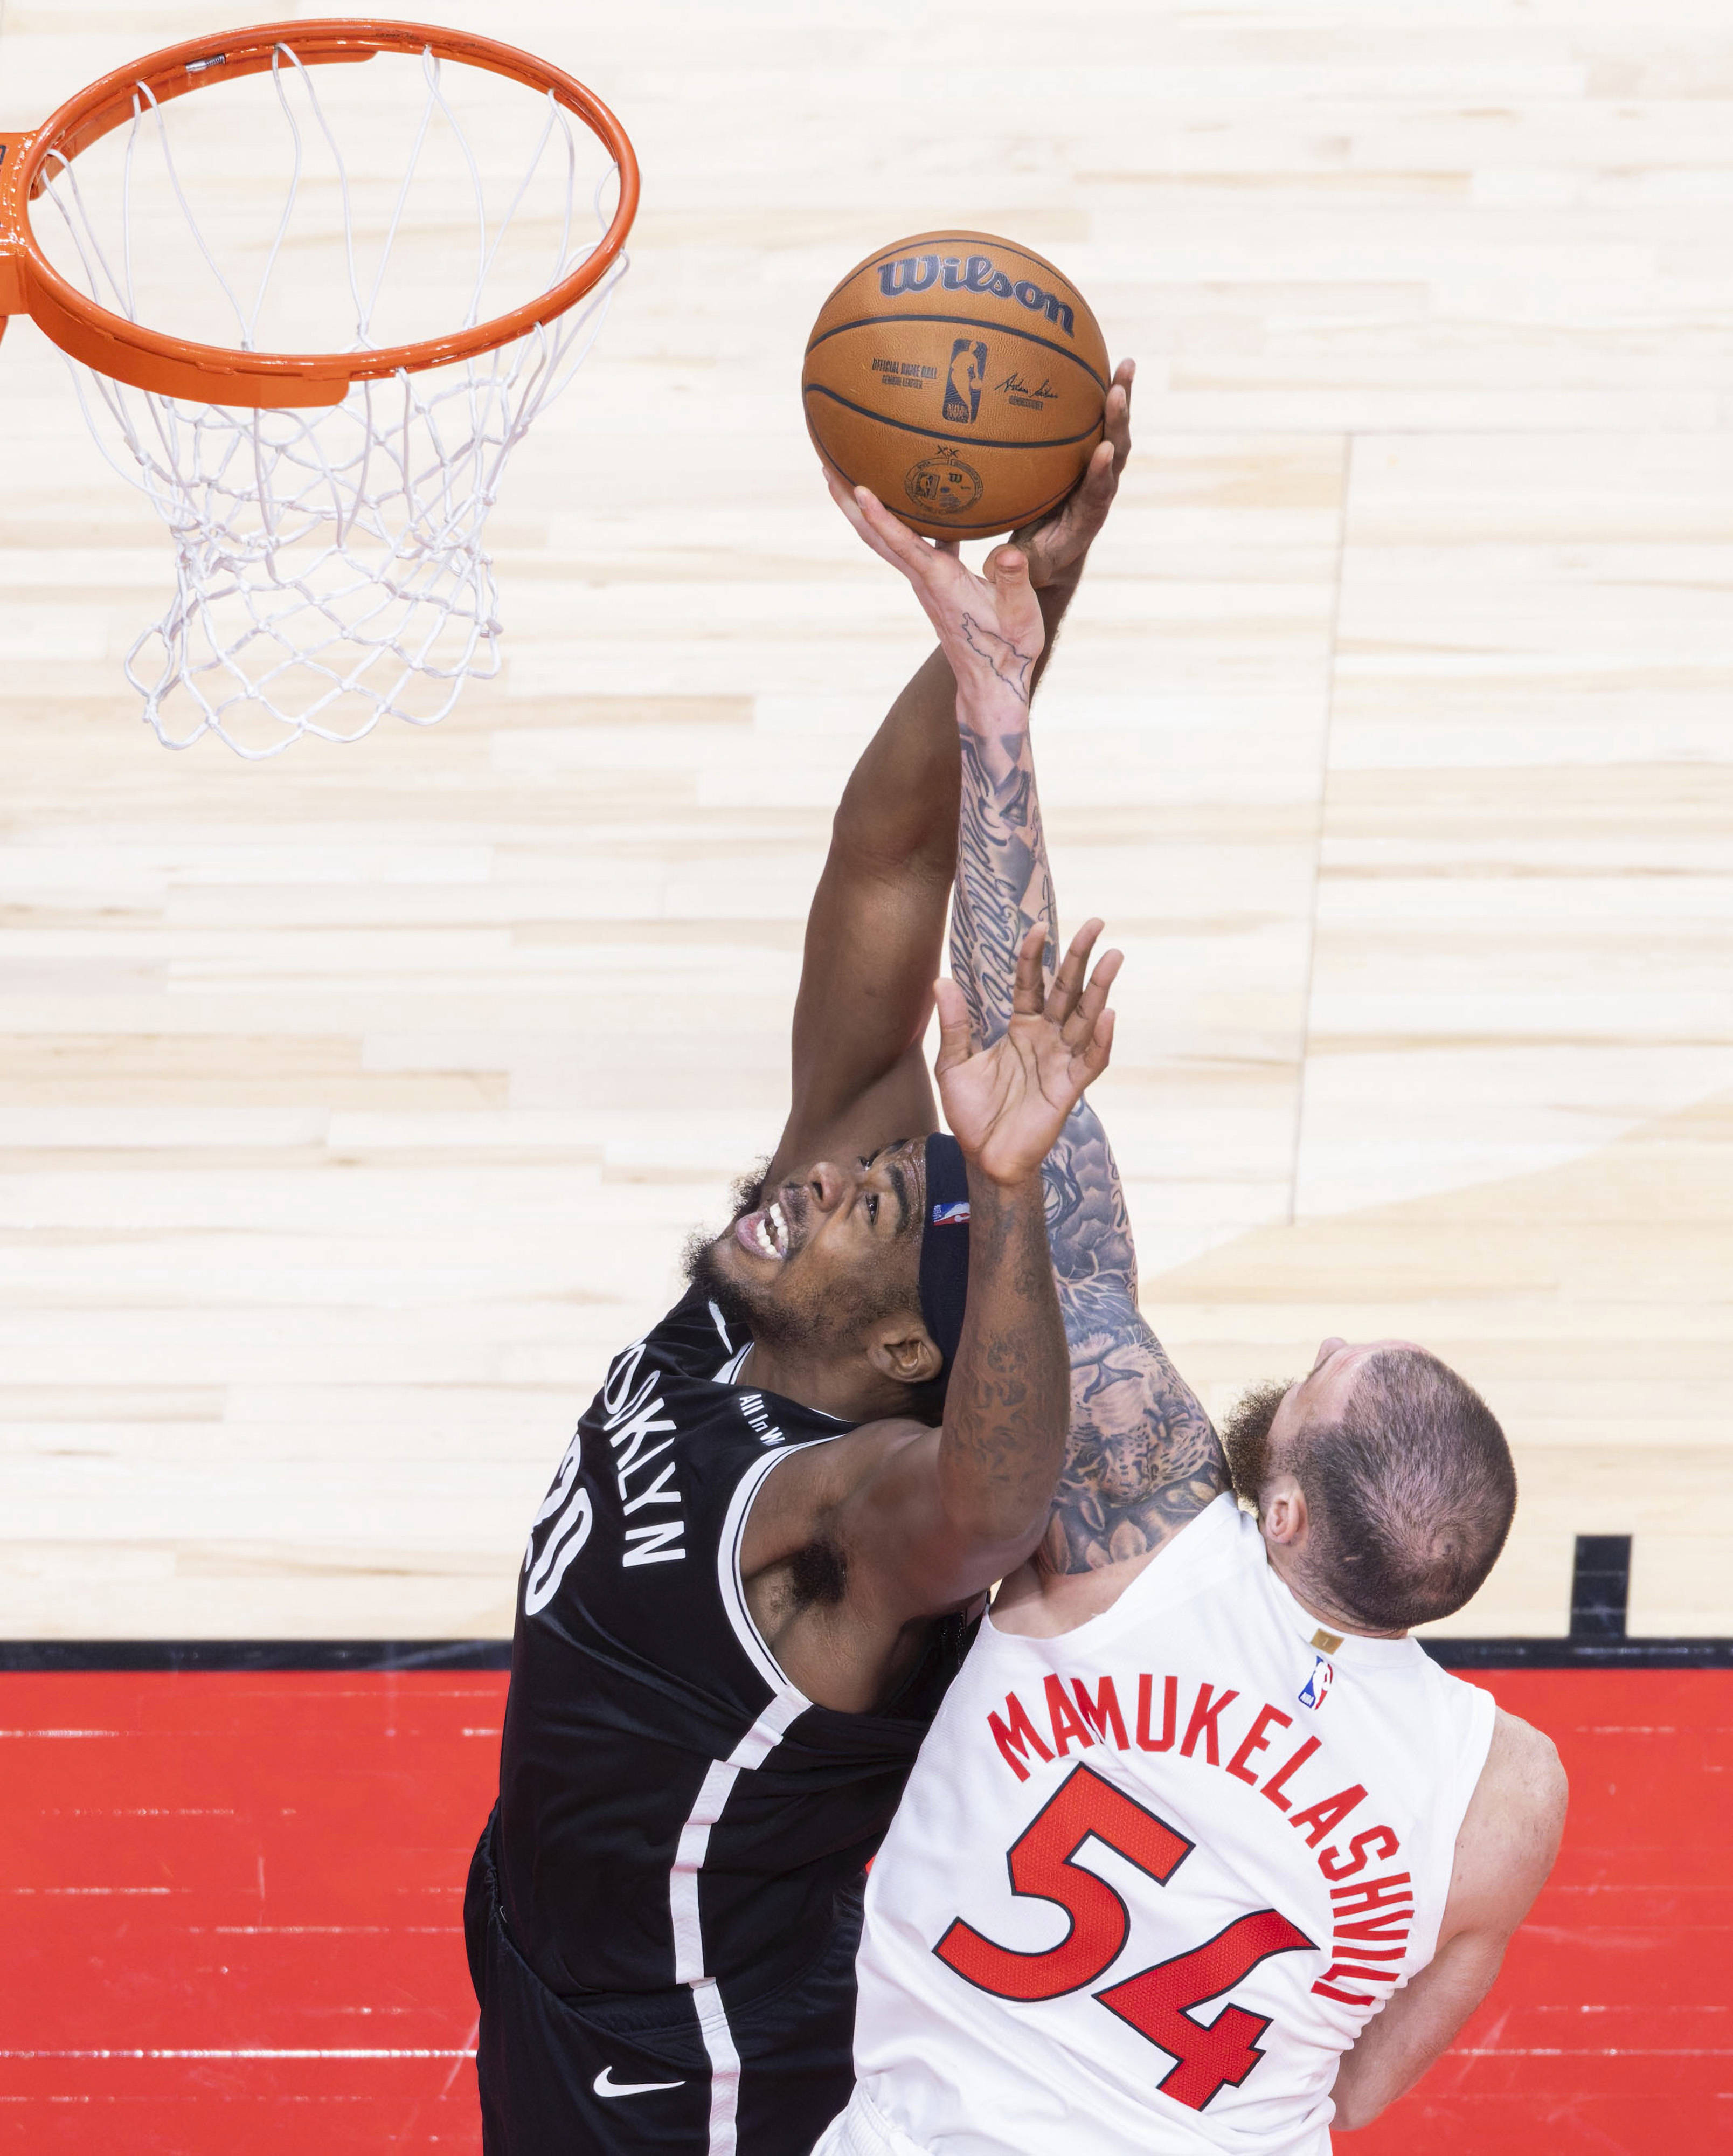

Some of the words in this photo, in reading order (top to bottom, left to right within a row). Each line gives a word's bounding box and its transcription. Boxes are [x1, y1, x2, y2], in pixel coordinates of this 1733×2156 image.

[877, 254, 1075, 338] Wilson
[739, 1394, 764, 1416] All
[748, 1413, 769, 1432] In
[760, 1426, 785, 1446] W
[602, 1335, 686, 1568] OOKLYN
[987, 1673, 1415, 2007] MAMUKELASHVILI
[932, 1761, 1320, 2112] 54
